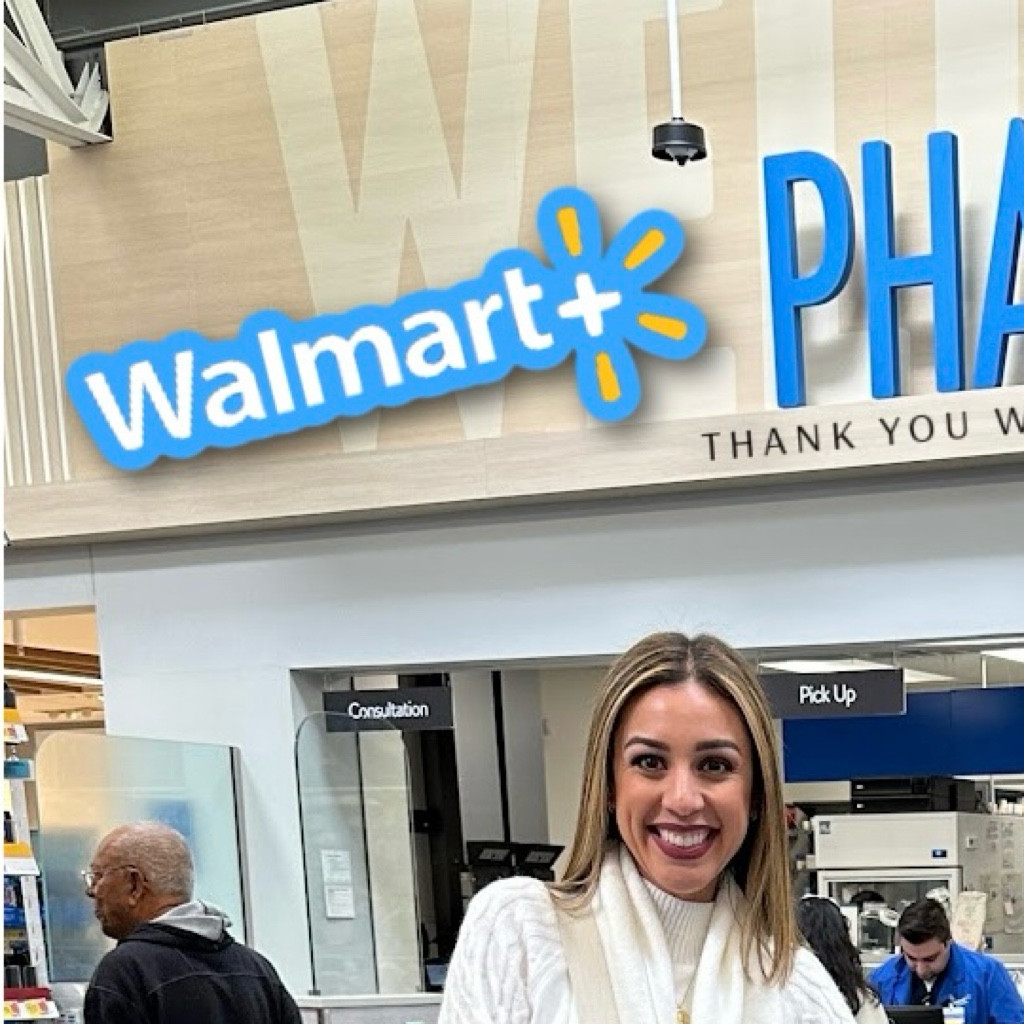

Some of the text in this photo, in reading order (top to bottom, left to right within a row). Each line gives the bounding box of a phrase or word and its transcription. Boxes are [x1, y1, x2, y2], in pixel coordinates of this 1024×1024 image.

[799, 684, 857, 708] Pick Up
[348, 700, 429, 719] Consultation
